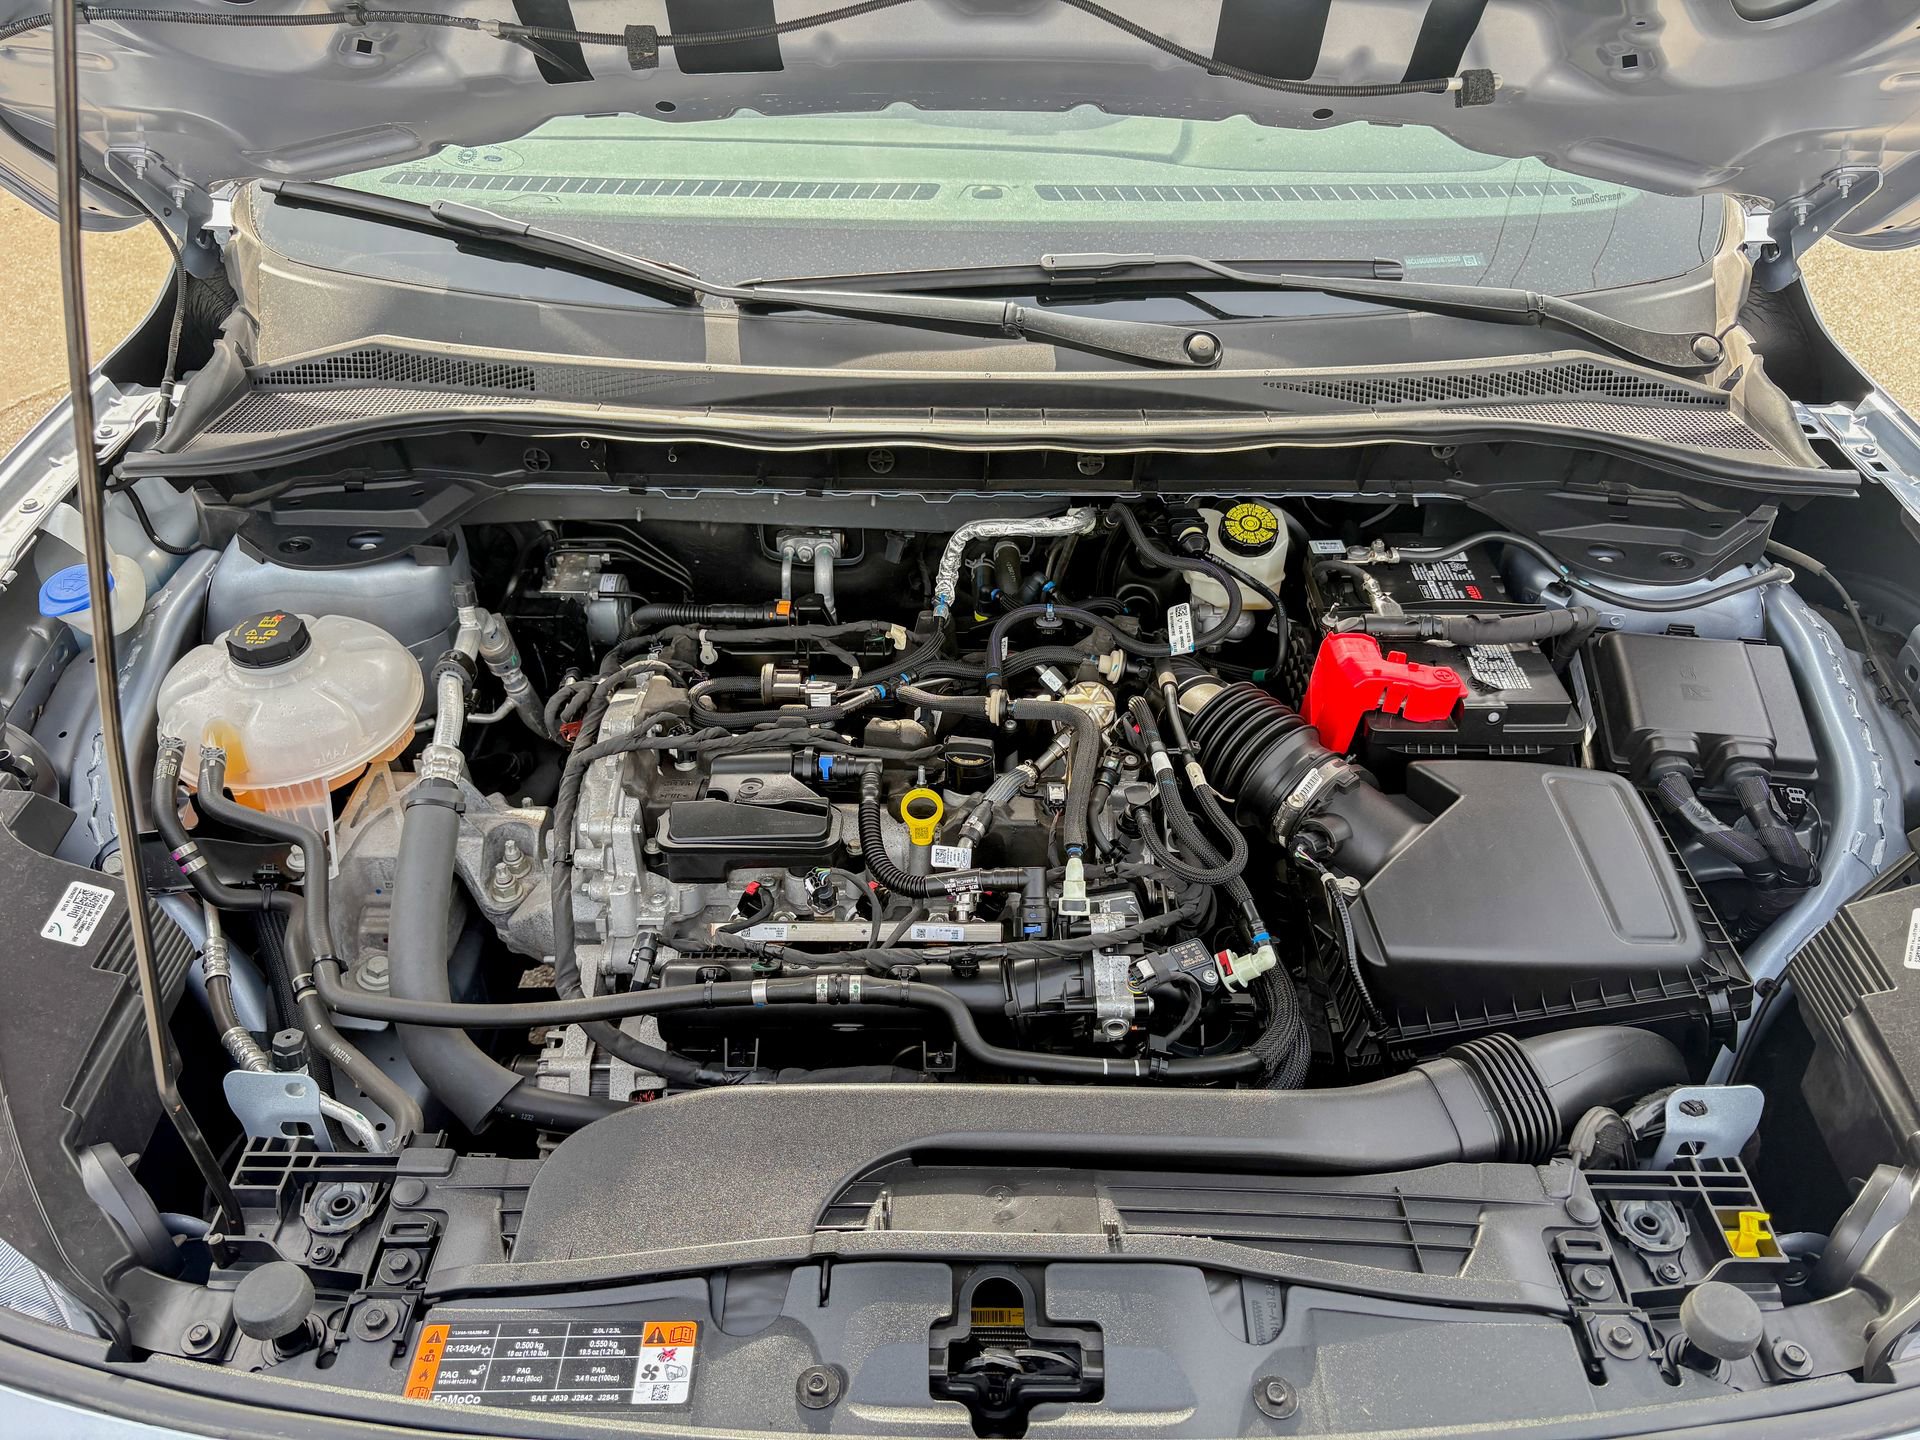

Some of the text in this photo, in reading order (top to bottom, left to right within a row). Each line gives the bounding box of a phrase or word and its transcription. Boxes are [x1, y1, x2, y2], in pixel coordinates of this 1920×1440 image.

[1571, 193, 1622, 206] SoundScreen
[446, 1344, 481, 1354] R-1234yf
[515, 1341, 544, 1350] 0.500 kg
[589, 1340, 618, 1349] 0.550 kg
[599, 1348, 614, 1356] (1.21
[614, 1348, 626, 1356] lbs)
[591, 1366, 606, 1374] PAG
[440, 1371, 459, 1379] PAG
[598, 1374, 620, 1383] (100cc)
[433, 1394, 481, 1404] FoMoCo
[551, 1394, 568, 1402] J639
